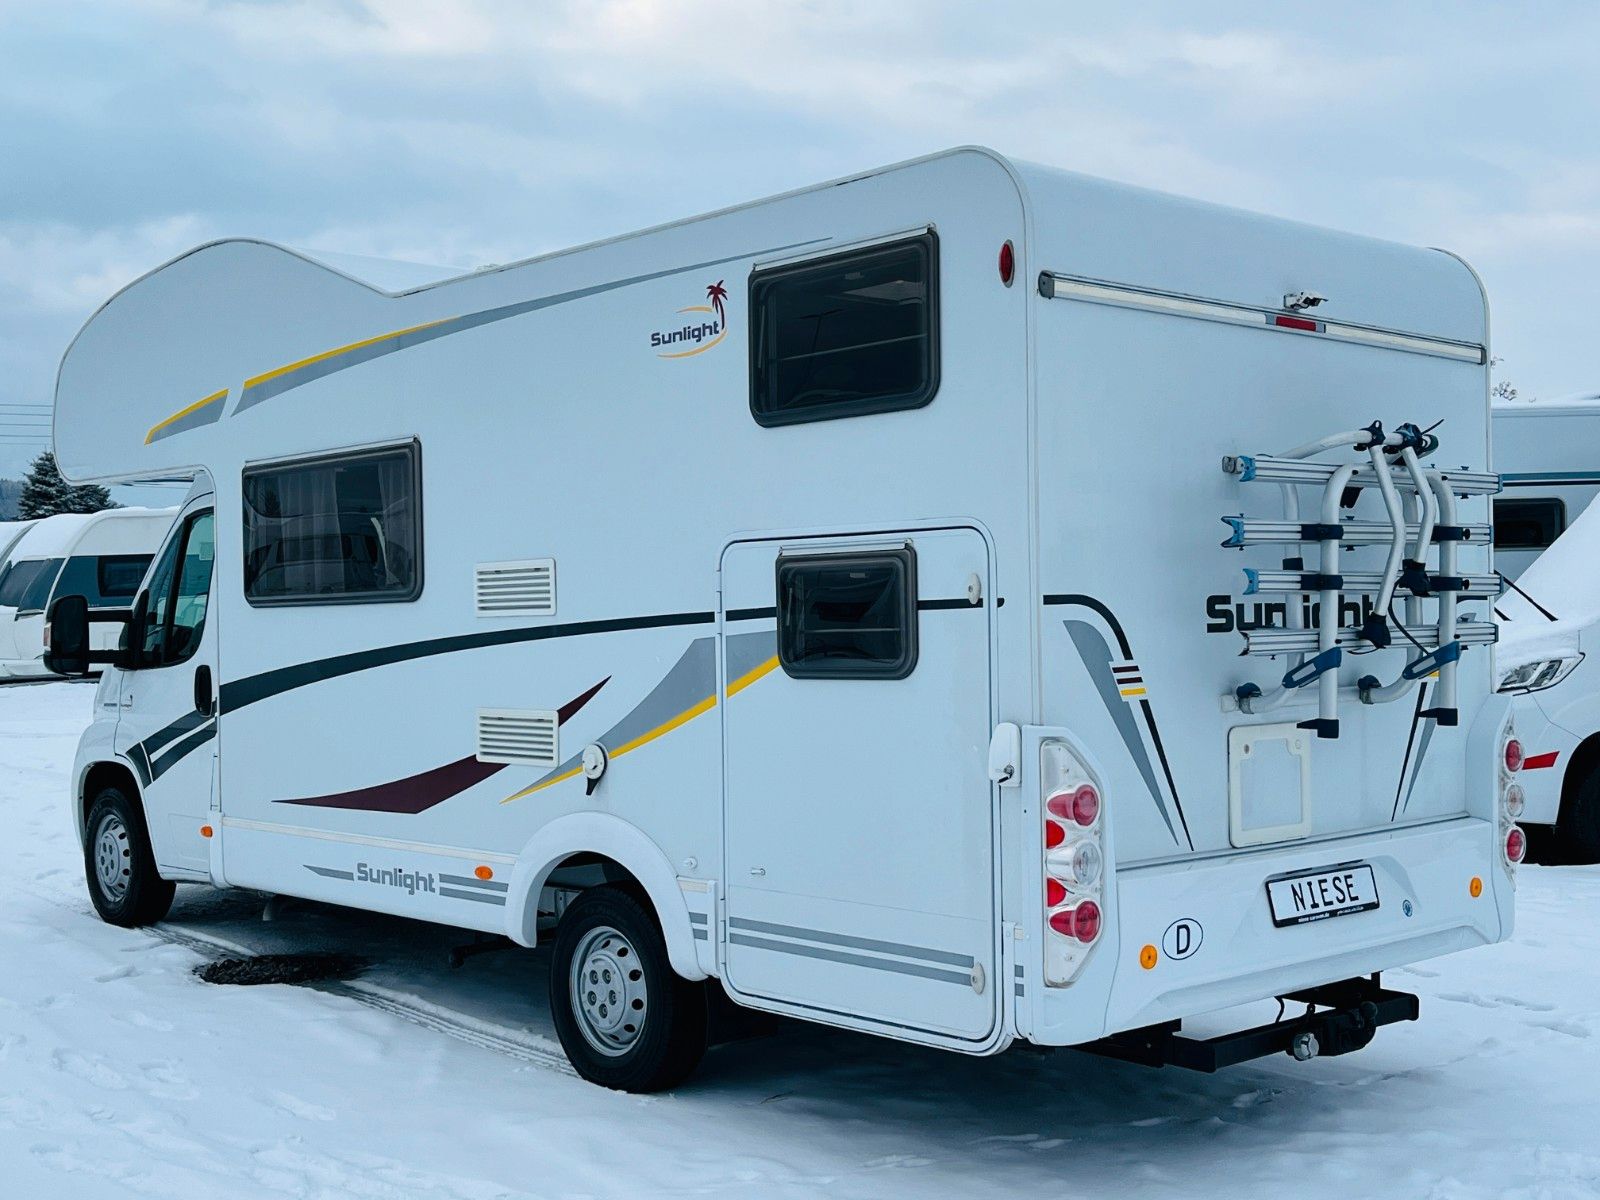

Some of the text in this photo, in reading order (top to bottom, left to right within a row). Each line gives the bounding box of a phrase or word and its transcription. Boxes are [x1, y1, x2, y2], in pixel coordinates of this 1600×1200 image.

[651, 321, 719, 347] Sunlight
[1206, 594, 1374, 633] Suniht
[357, 862, 436, 896] Sunlight
[1291, 874, 1359, 911] NIESE
[1176, 924, 1191, 955] D
